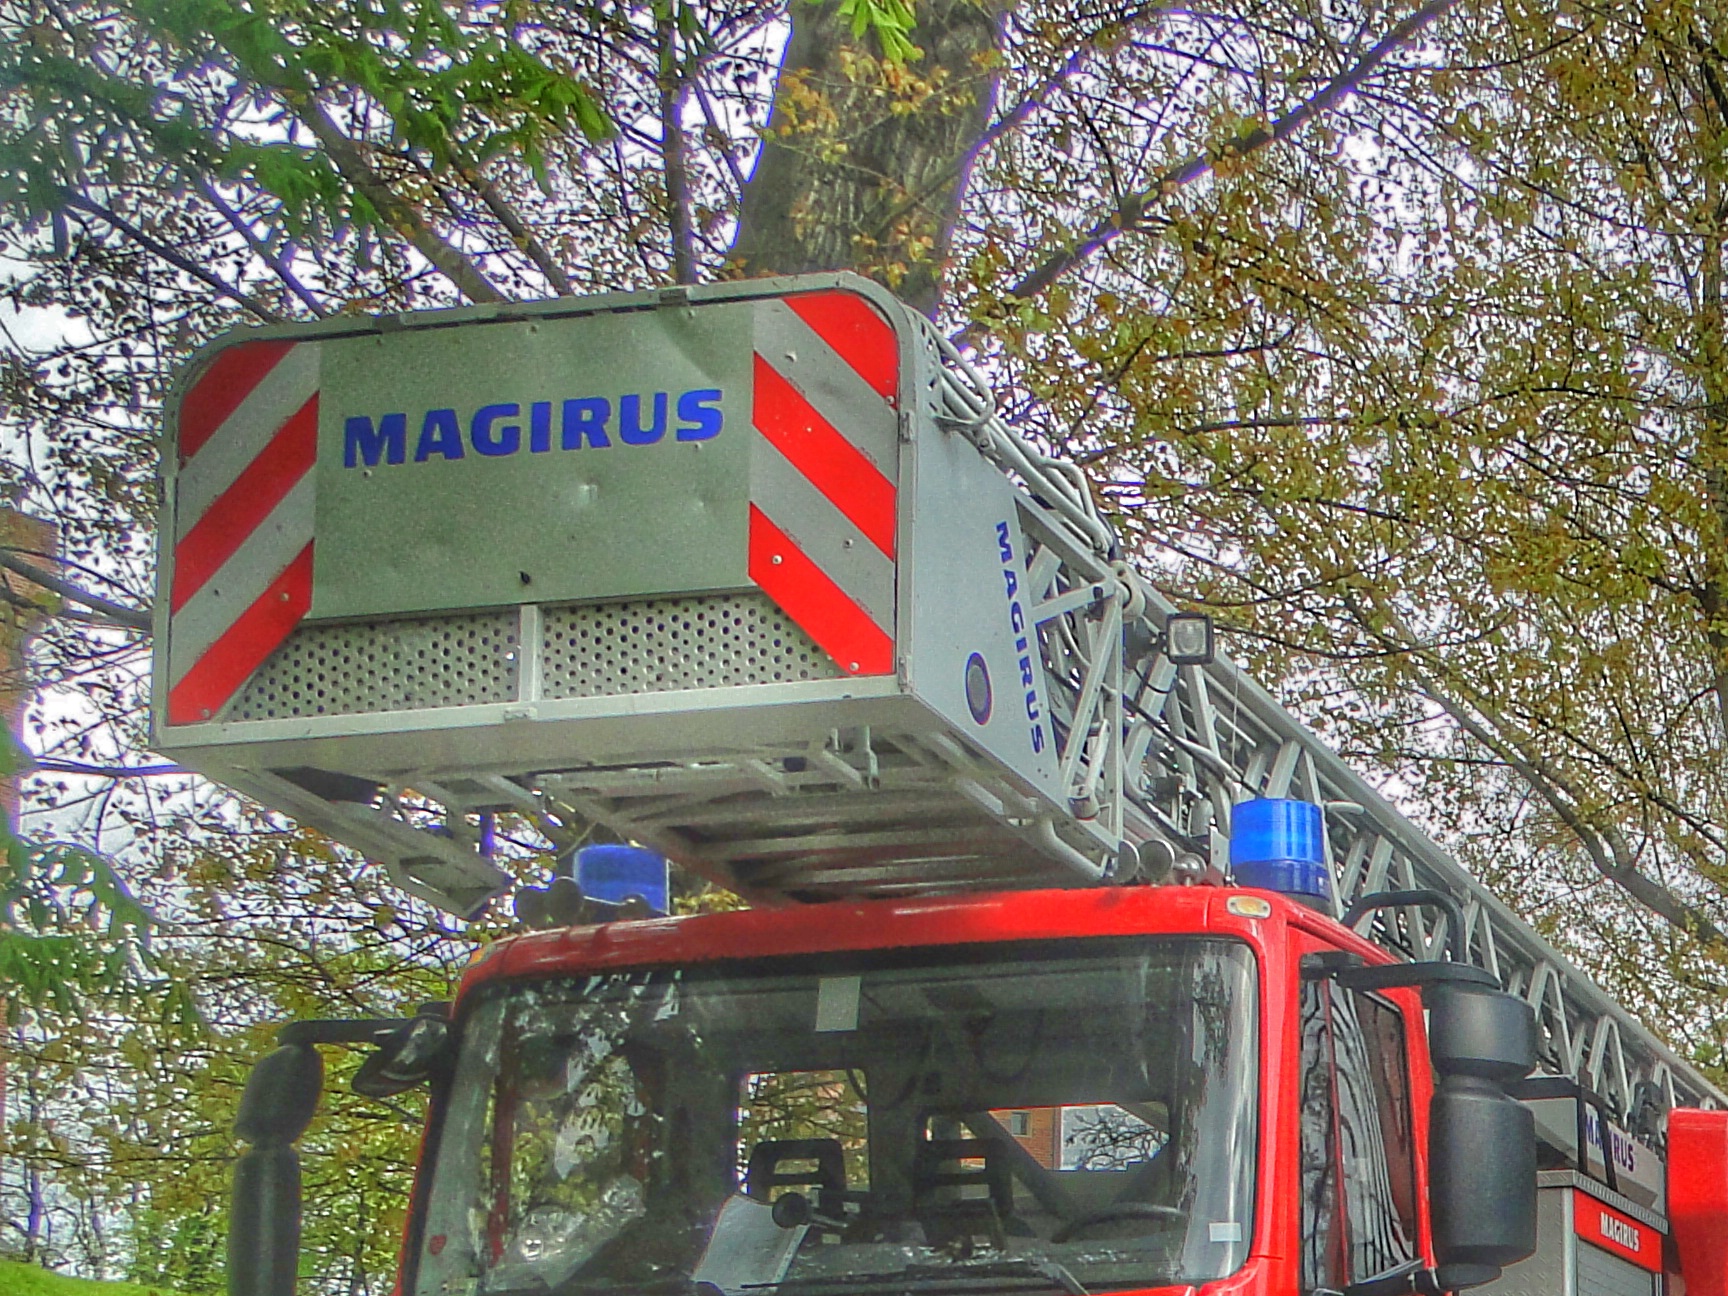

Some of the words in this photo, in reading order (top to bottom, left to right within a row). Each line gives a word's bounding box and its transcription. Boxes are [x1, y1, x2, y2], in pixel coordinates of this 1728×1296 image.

[344, 389, 724, 468] MAGIRUS
[996, 521, 1045, 754] MAGIRUS
[1600, 1211, 1640, 1253] MAGIRUS
